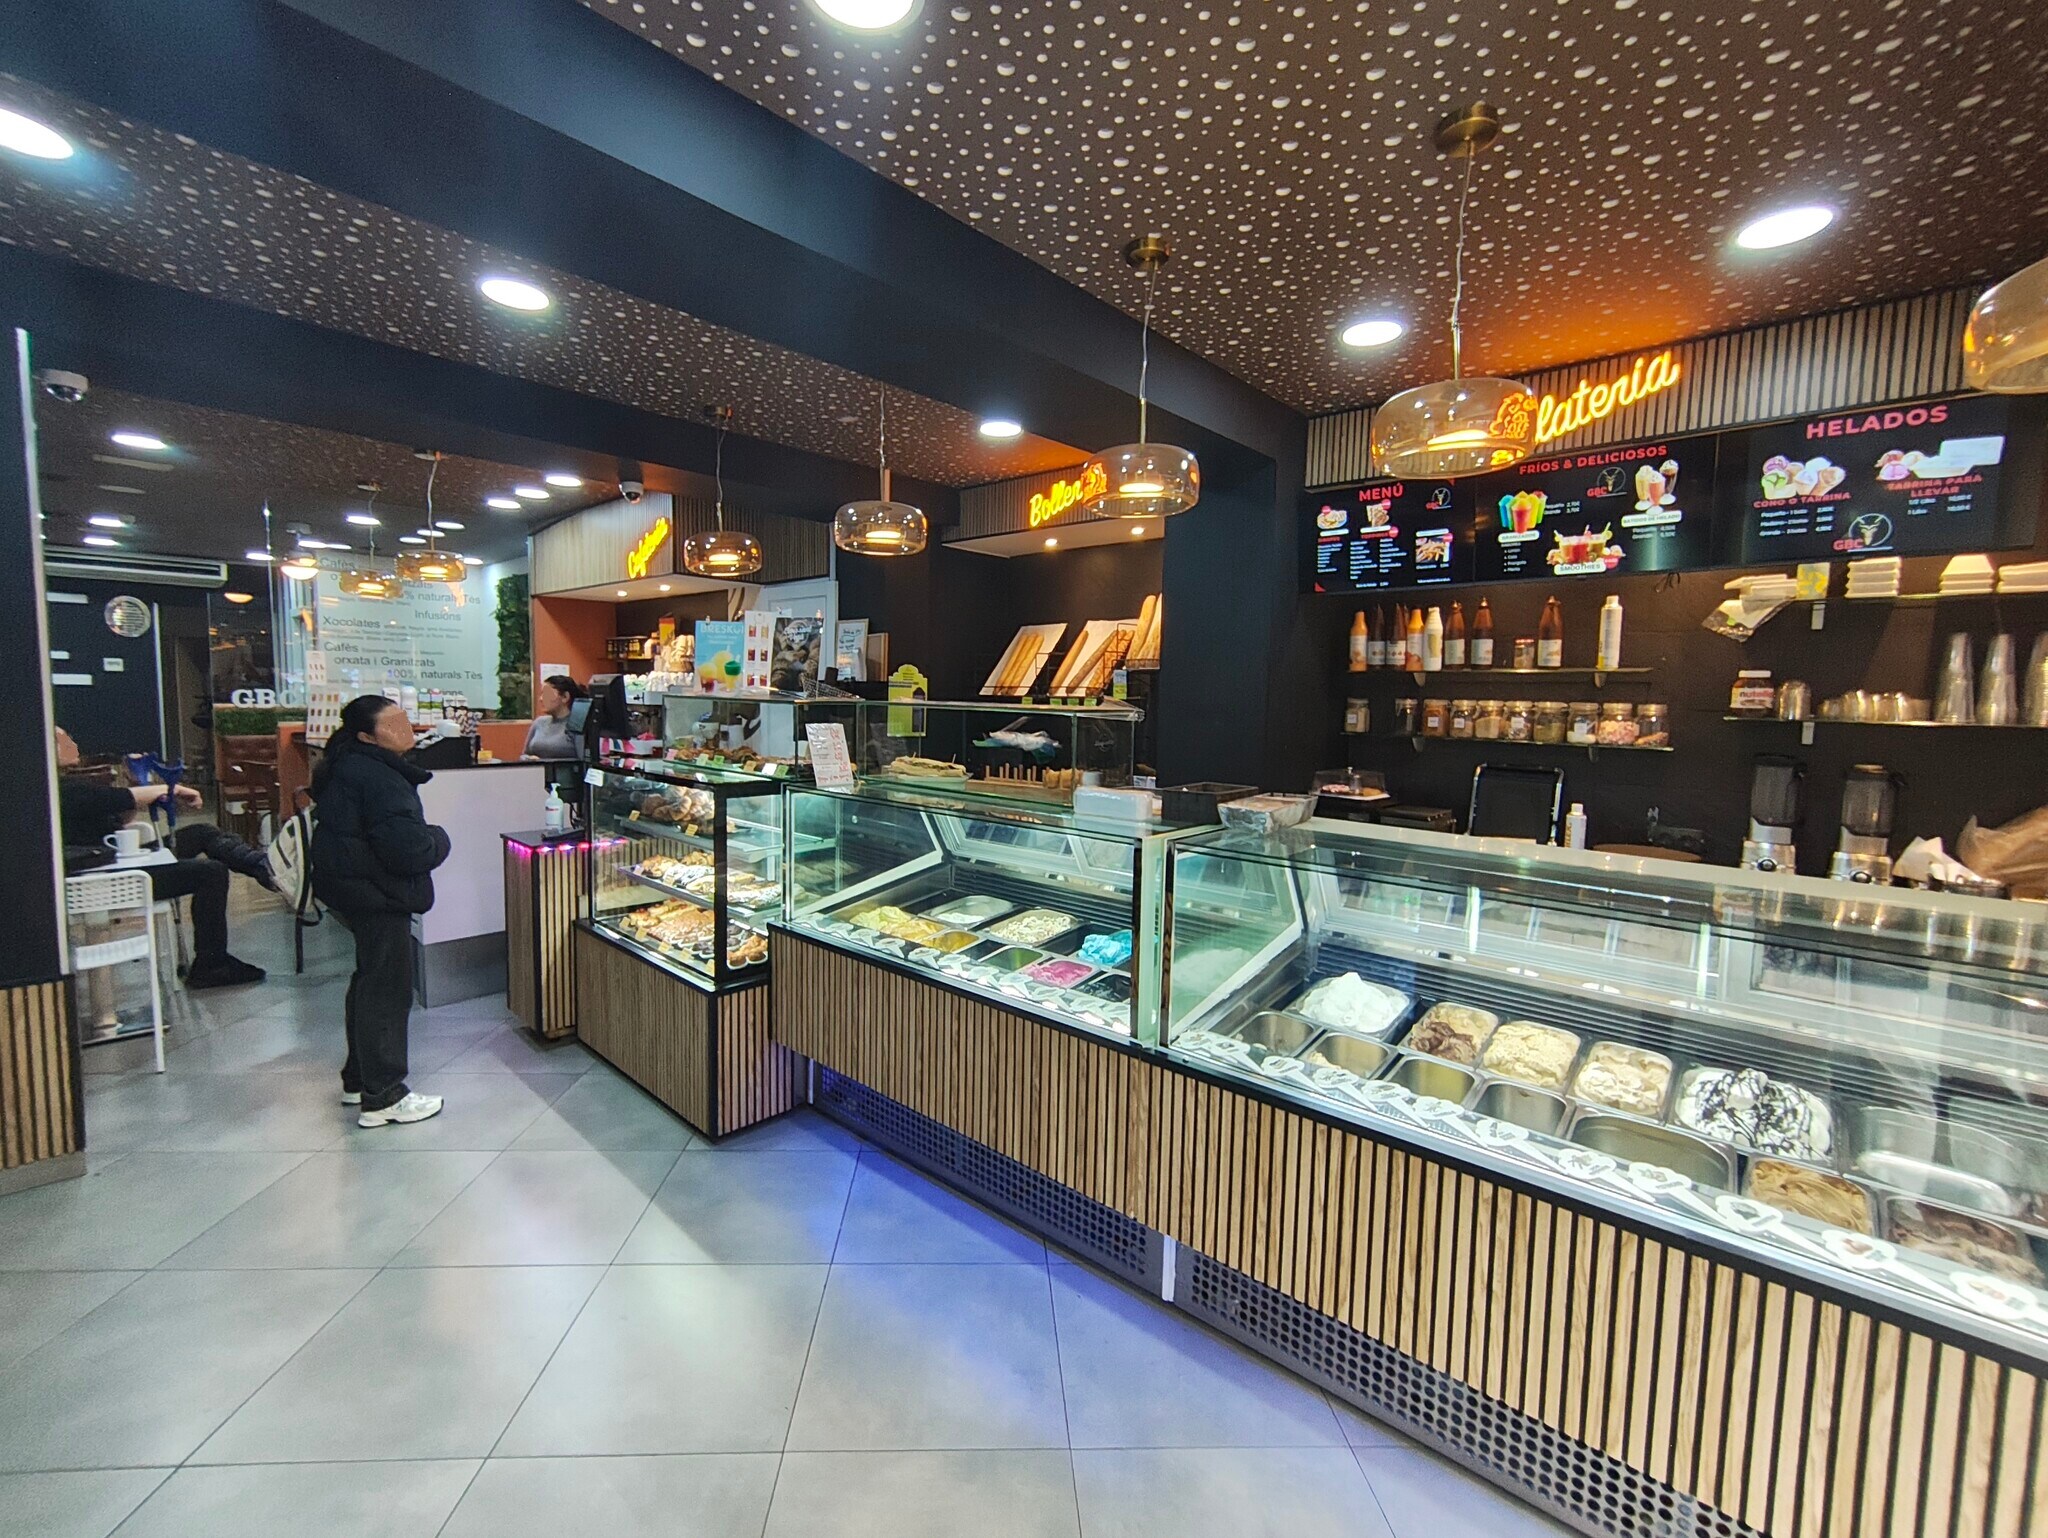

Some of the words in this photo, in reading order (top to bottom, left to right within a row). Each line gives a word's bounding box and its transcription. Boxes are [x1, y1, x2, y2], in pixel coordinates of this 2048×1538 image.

[1531, 350, 1681, 444] lateria
[1806, 404, 1950, 440] HELADOS
[1519, 458, 1559, 476] FRÍOS
[1563, 458, 1574, 470] &
[1577, 445, 1668, 467] DELICIOSOS
[1887, 479, 1942, 490] TARRINA
[1945, 474, 1984, 485] PARA
[1359, 483, 1404, 501] MENÚ
[1587, 486, 1608, 498] GBC
[1910, 486, 1961, 498] LLEVAR
[1753, 499, 1786, 508] CONO
[1801, 492, 1851, 503] TARRINA
[1833, 538, 1864, 551] GBC
[1560, 563, 1601, 572] SMOOTHIES
[414, 609, 462, 621] Infusions
[323, 615, 381, 629] Xocolates
[334, 655, 371, 667] orxata
[420, 669, 463, 681] naturals
